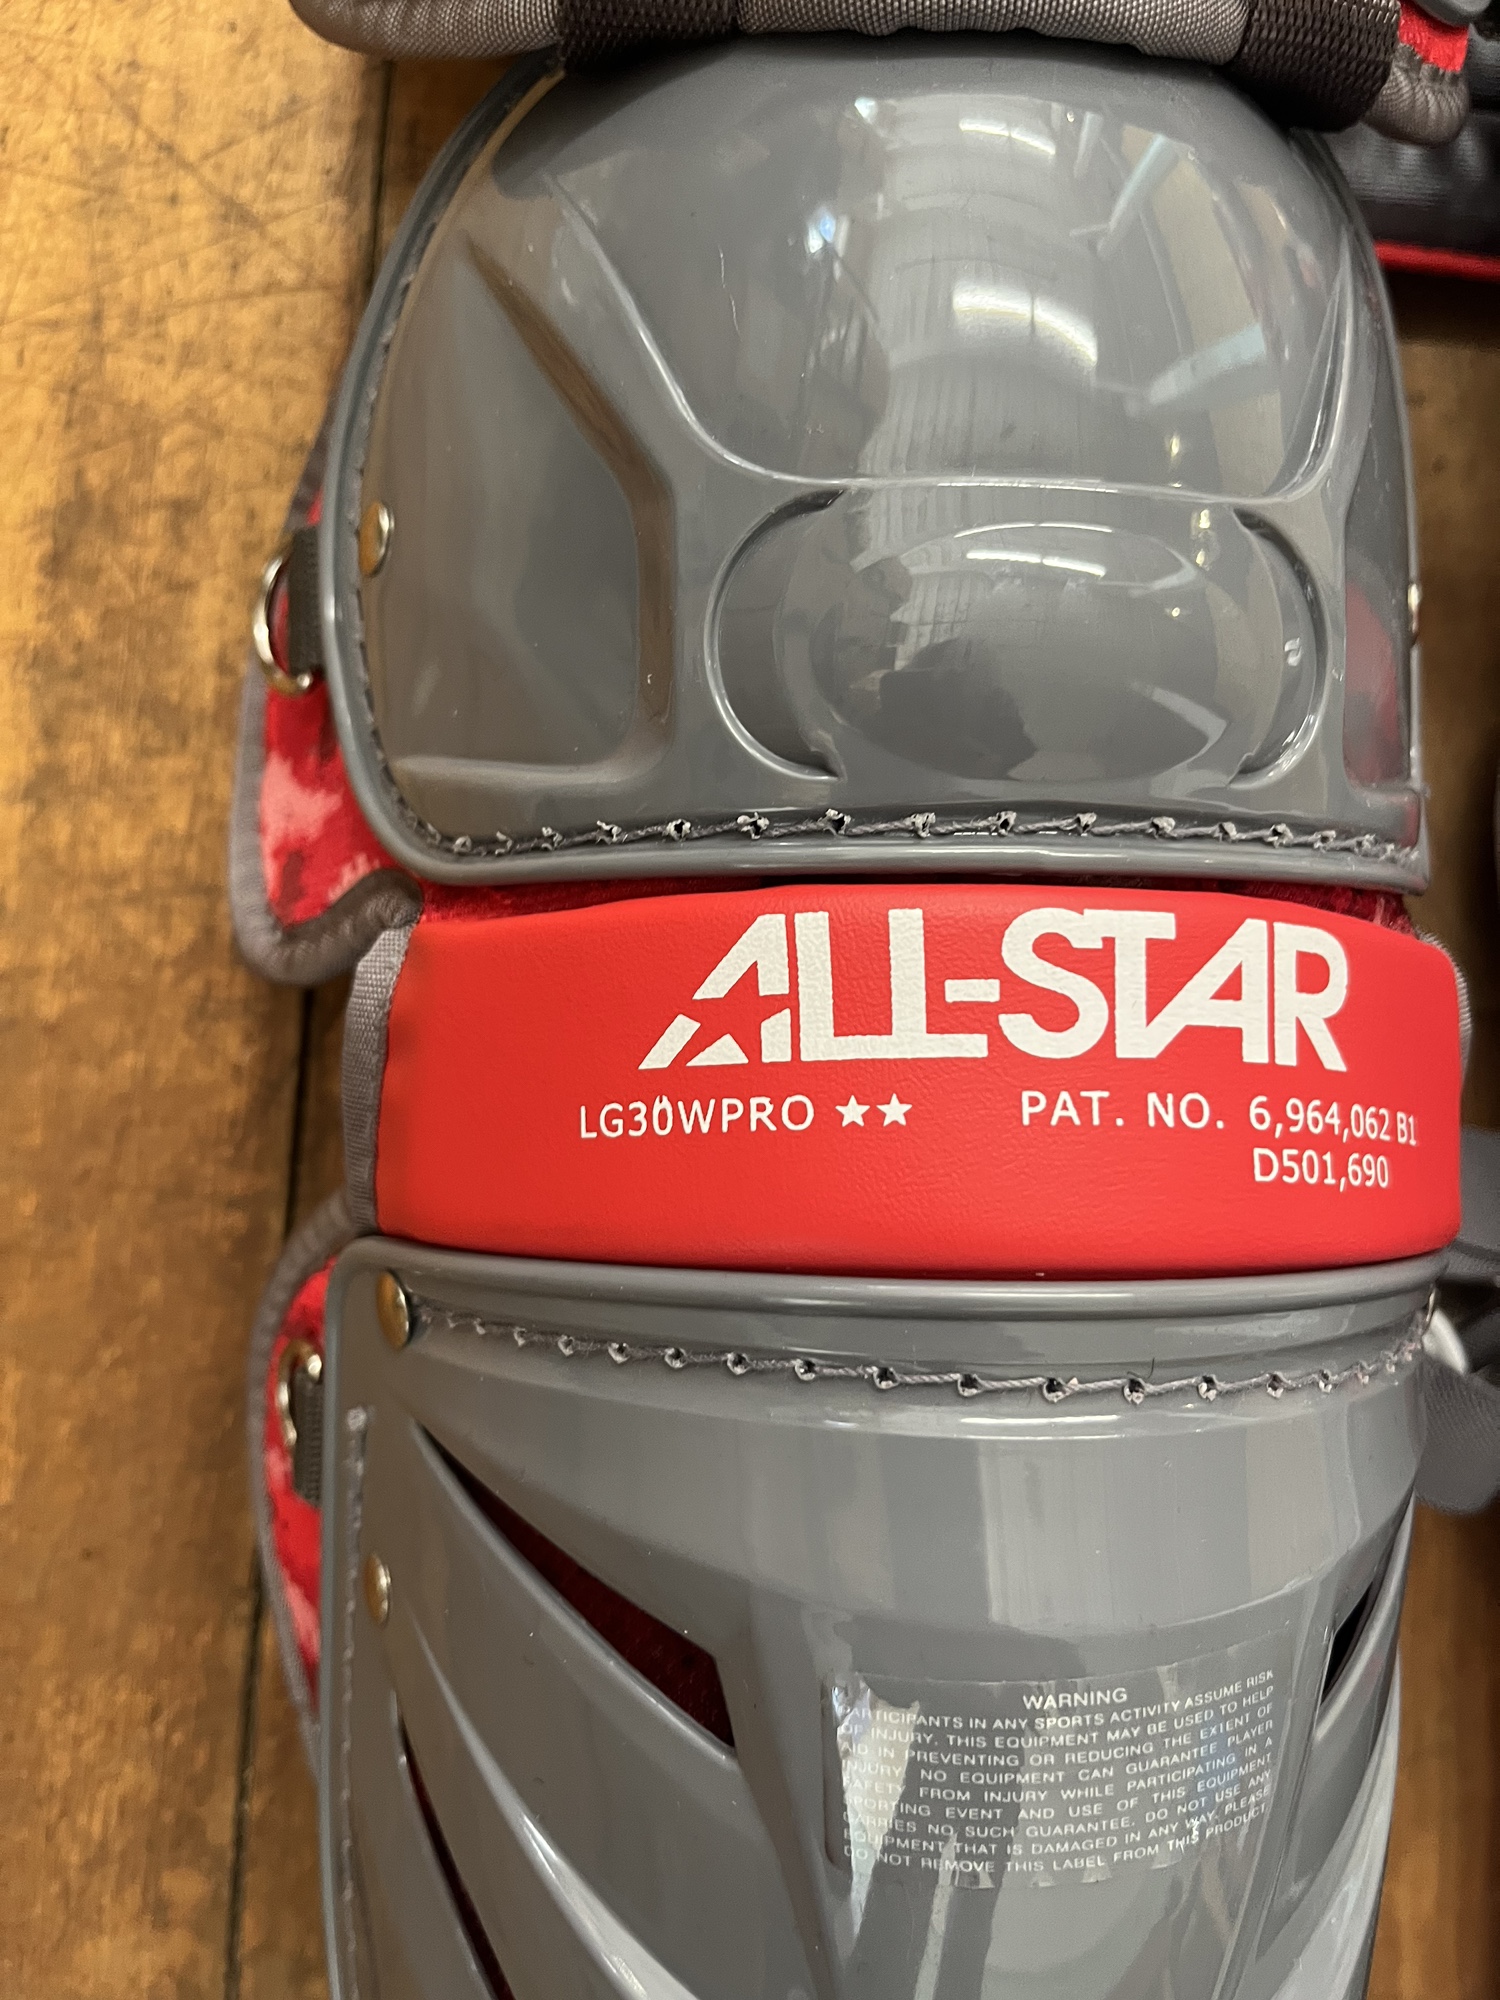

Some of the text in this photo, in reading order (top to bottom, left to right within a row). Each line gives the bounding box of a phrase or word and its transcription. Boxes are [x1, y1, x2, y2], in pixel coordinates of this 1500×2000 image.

[638, 907, 1350, 1072] ALL-STAR
[580, 1094, 815, 1139] LG30WPRO
[1020, 1090, 1419, 1147] PAT. NO. 6,964,062 B1
[1252, 1147, 1391, 1193] D501,690
[841, 1685, 1274, 1749] OF INJURY. THIS EQUIPMENT MAY BE USED TO HELP
[969, 1717, 987, 1730] IN
[992, 1718, 1028, 1730] ANY
[1034, 1713, 1105, 1730] SPORTS
[1110, 1700, 1181, 1724] ACTIVITY
[1184, 1680, 1243, 1710] ASSUME
[1246, 1669, 1274, 1689] RISK
[1022, 1687, 1128, 1710] WARNING
[841, 1702, 1273, 1767] AID IN PREVENTING OR REDUCING THE EXTENT OF
[920, 1768, 948, 1782] NO
[960, 1771, 1065, 1785] EQUIPMENT
[1078, 1766, 1114, 1781] CAN
[1126, 1742, 1218, 1775] GUARANTEE
[1227, 1719, 1274, 1748] PLAYER
[919, 1786, 971, 1801] FROM
[984, 1790, 1048, 1803] INJURY
[1060, 1783, 1115, 1800] WHILE
[1127, 1753, 1236, 1792] PARTICIPATING
[1244, 1743, 1257, 1758] IN
[1264, 1736, 1273, 1749] A
[945, 1806, 1004, 1820] EVENT
[1018, 1807, 1055, 1820] AND
[1068, 1802, 1103, 1818] USE
[1116, 1797, 1139, 1812] OF
[1151, 1786, 1186, 1804] THIS
[1197, 1752, 1272, 1793] EQUIPMENT
[927, 1823, 954, 1836] NO
[965, 1825, 1015, 1838] SUCH
[1025, 1816, 1136, 1838] GUARANTEE.
[1145, 1808, 1168, 1823] DO
[1177, 1796, 1208, 1815] NOT
[1215, 1783, 1241, 1803] USE
[1248, 1769, 1272, 1789] ANY
[953, 1841, 998, 1856] THAT
[1006, 1843, 1023, 1856] IS
[1031, 1835, 1118, 1855] DAMAGED
[1124, 1830, 1141, 1844] IN
[1147, 1821, 1179, 1838] ANY
[1224, 1784, 1272, 1816] PLEASE
[877, 1850, 912, 1867] NOT
[921, 1857, 996, 1873] REMOVE
[1006, 1860, 1044, 1873] THIS
[1052, 1855, 1106, 1871] LABEL
[1113, 1844, 1159, 1862] FROM
[1167, 1834, 1199, 1852] THIS
